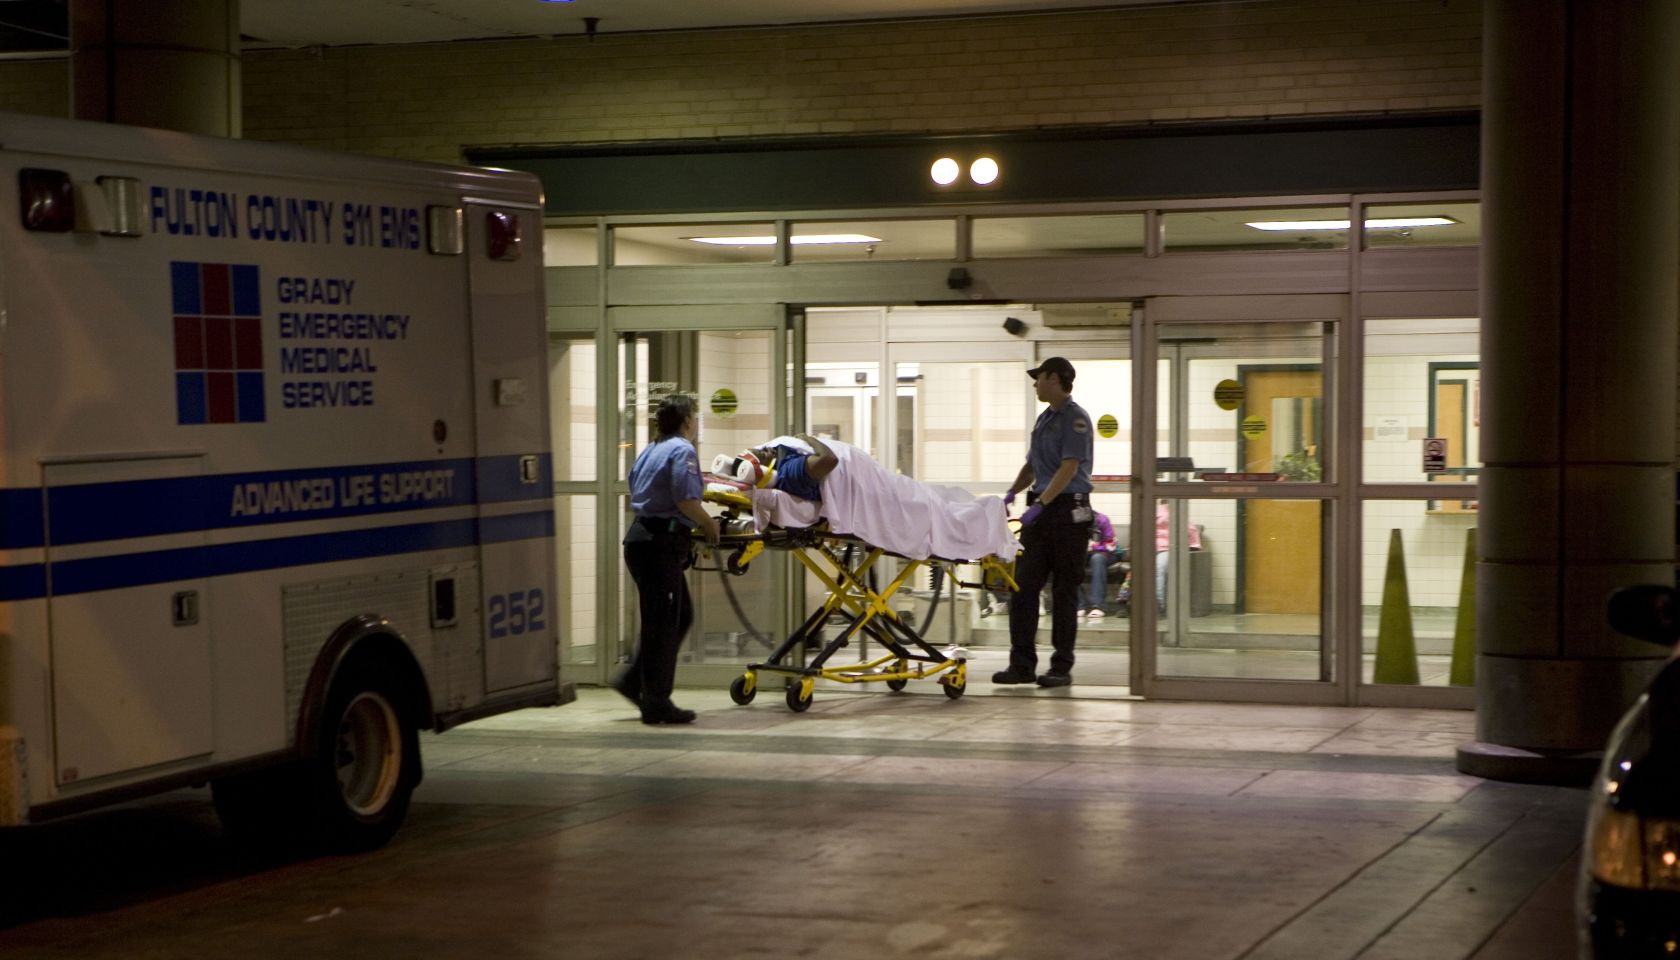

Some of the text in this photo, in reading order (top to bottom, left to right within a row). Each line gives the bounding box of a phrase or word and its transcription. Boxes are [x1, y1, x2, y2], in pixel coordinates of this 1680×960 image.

[151, 186, 419, 249] FULTON COUNTY 911 EMS
[278, 277, 355, 305] GRADY
[280, 312, 410, 339] EMERGENCY
[281, 348, 377, 373] MEDICAL
[283, 381, 373, 408] SERVICE
[231, 469, 454, 517] ADVANCED LIFE SUPPORT
[488, 588, 545, 639] 252
